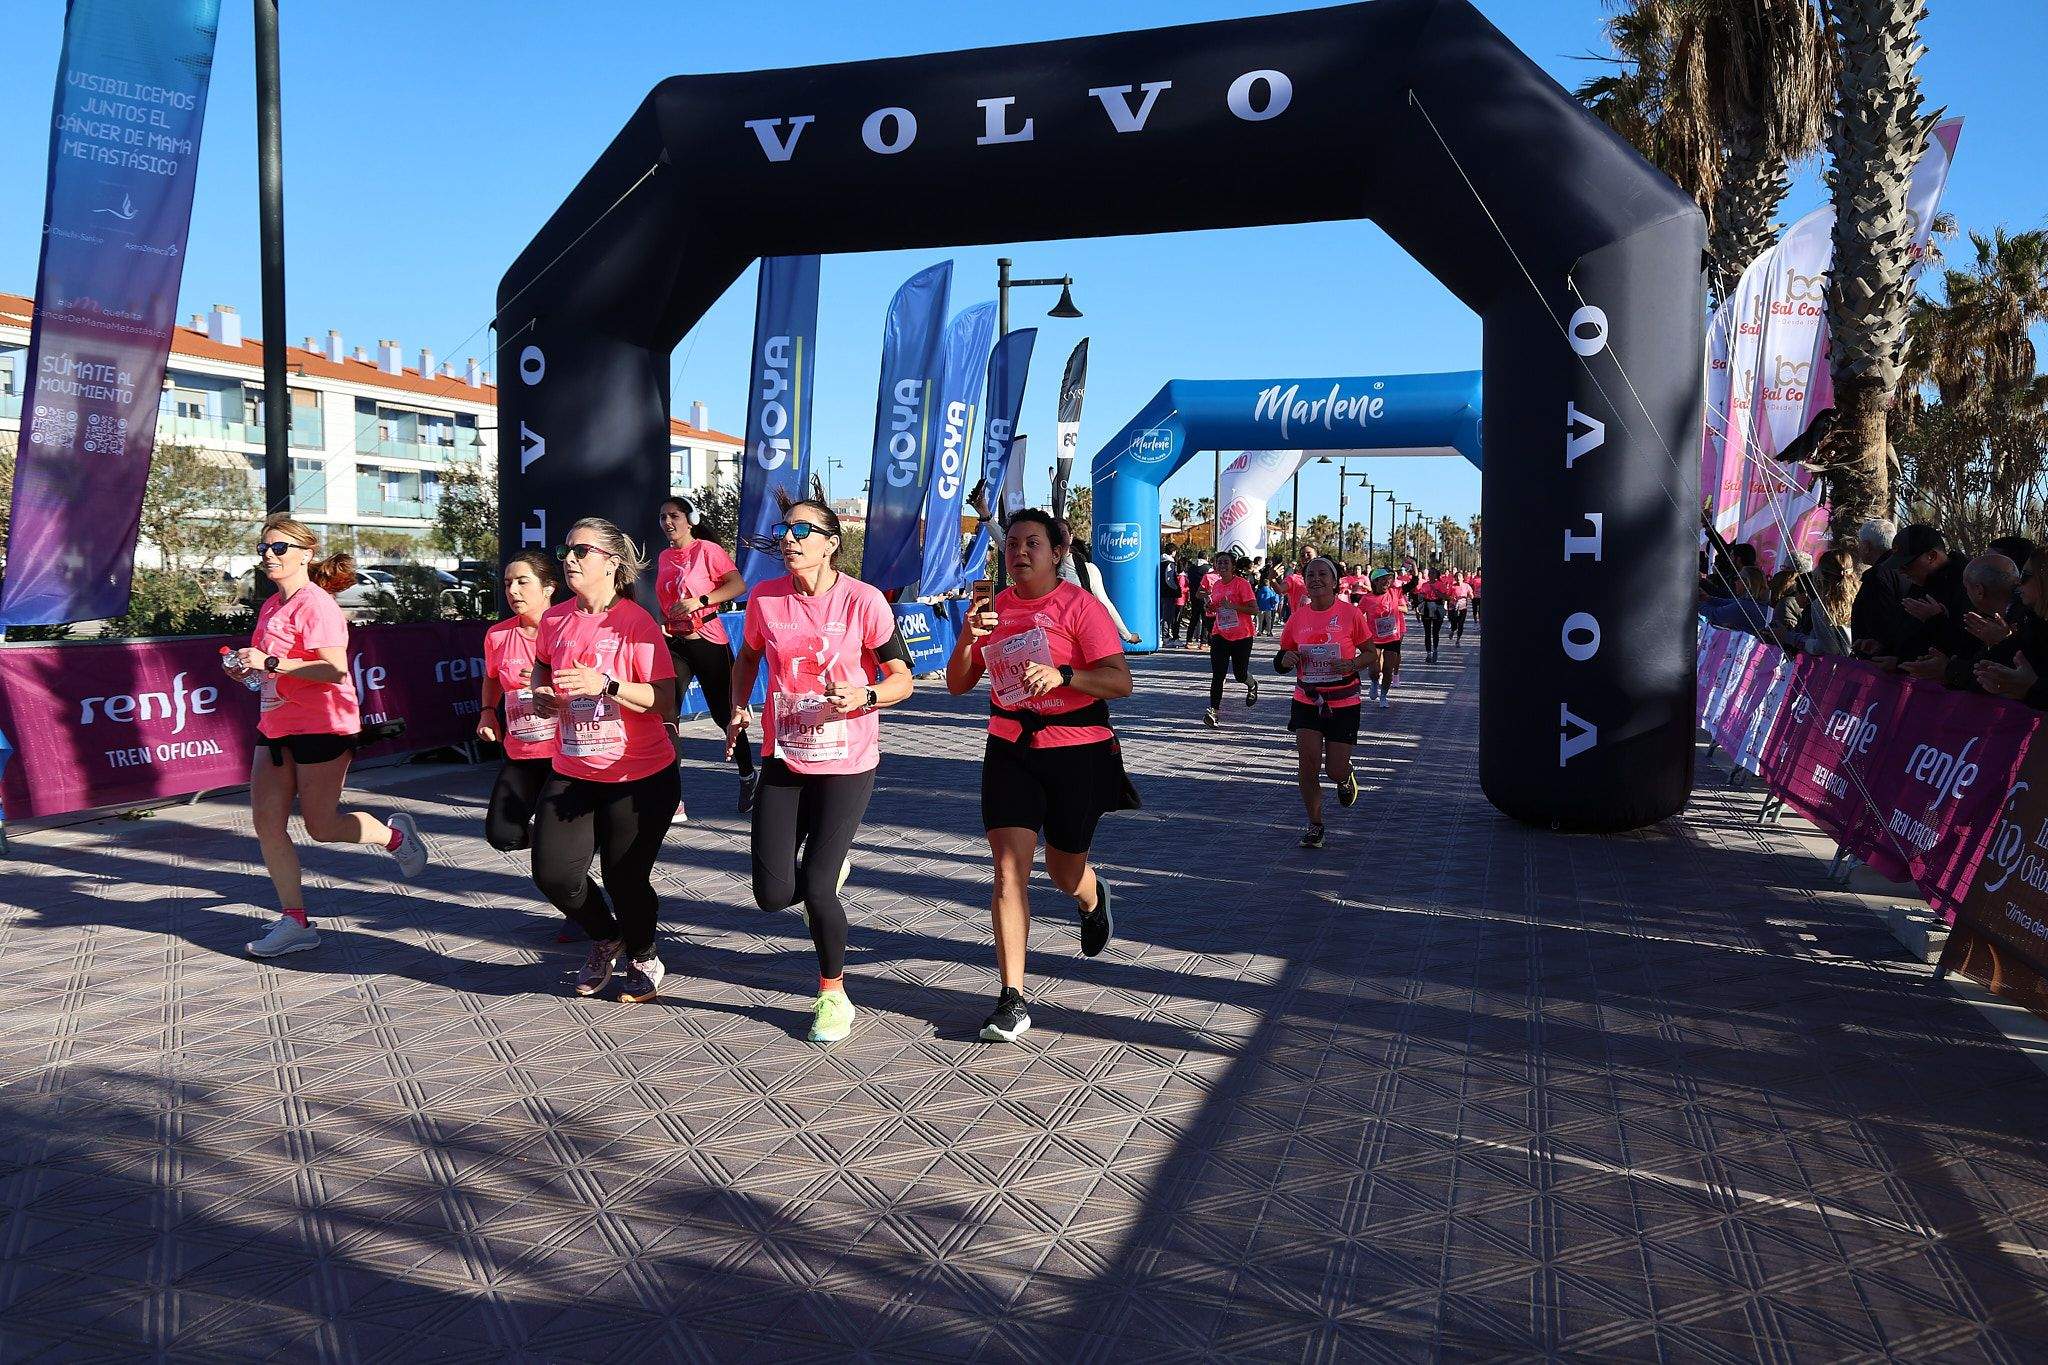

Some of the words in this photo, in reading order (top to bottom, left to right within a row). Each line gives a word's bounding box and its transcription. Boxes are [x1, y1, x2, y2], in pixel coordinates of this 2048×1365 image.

[67, 70, 196, 111] VISIBILICEMOS
[81, 97, 147, 123] JUNTOS
[150, 110, 170, 129] EL
[745, 69, 1293, 162] VOLVO
[55, 112, 121, 142] CÁNCER
[124, 128, 145, 146] DE
[148, 134, 192, 155] MAMA
[64, 139, 178, 176] METASTÁSICO
[39, 376, 132, 404] MOVIMIENTO
[41, 352, 116, 383] SÚMATE
[117, 371, 136, 388] AL
[757, 335, 790, 471] GOYA
[886, 378, 923, 488] GOYA
[938, 400, 967, 500] GOYA
[1559, 305, 1609, 768] VOLVO
[80, 671, 219, 735] renfe
[105, 746, 152, 768] TREN
[156, 738, 223, 762] OFICIAL
[1824, 701, 1878, 764] renfe
[1904, 736, 1979, 811] renfe
[1888, 808, 1912, 837] TREN
